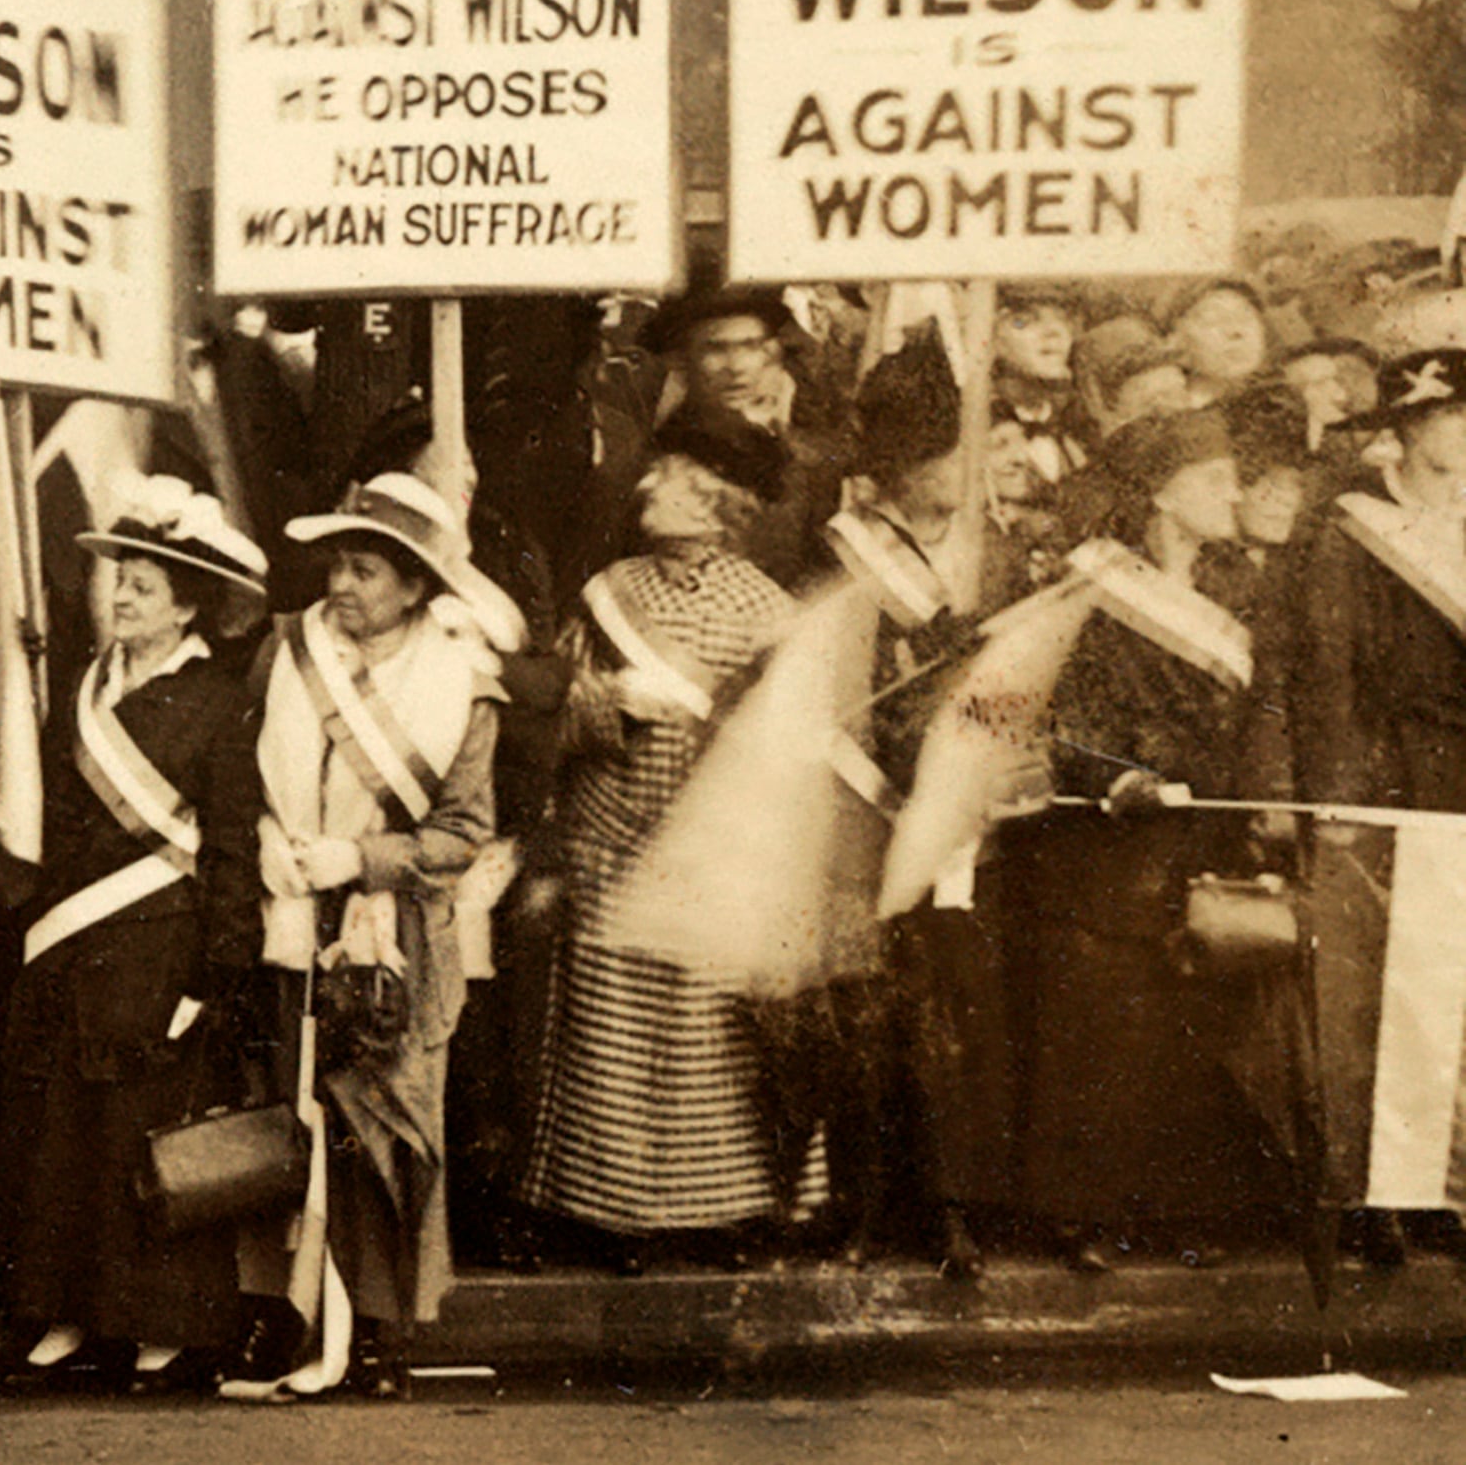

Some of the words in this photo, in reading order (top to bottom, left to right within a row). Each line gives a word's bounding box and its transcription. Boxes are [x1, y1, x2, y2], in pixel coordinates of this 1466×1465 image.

[950, 32, 1019, 67] IS
[361, 68, 608, 121] OPPOSES
[778, 84, 1198, 160] AGAINST
[332, 143, 551, 188] NATIONAL
[401, 199, 639, 248] SUFFRAGE
[804, 170, 1142, 241] WOMEN
